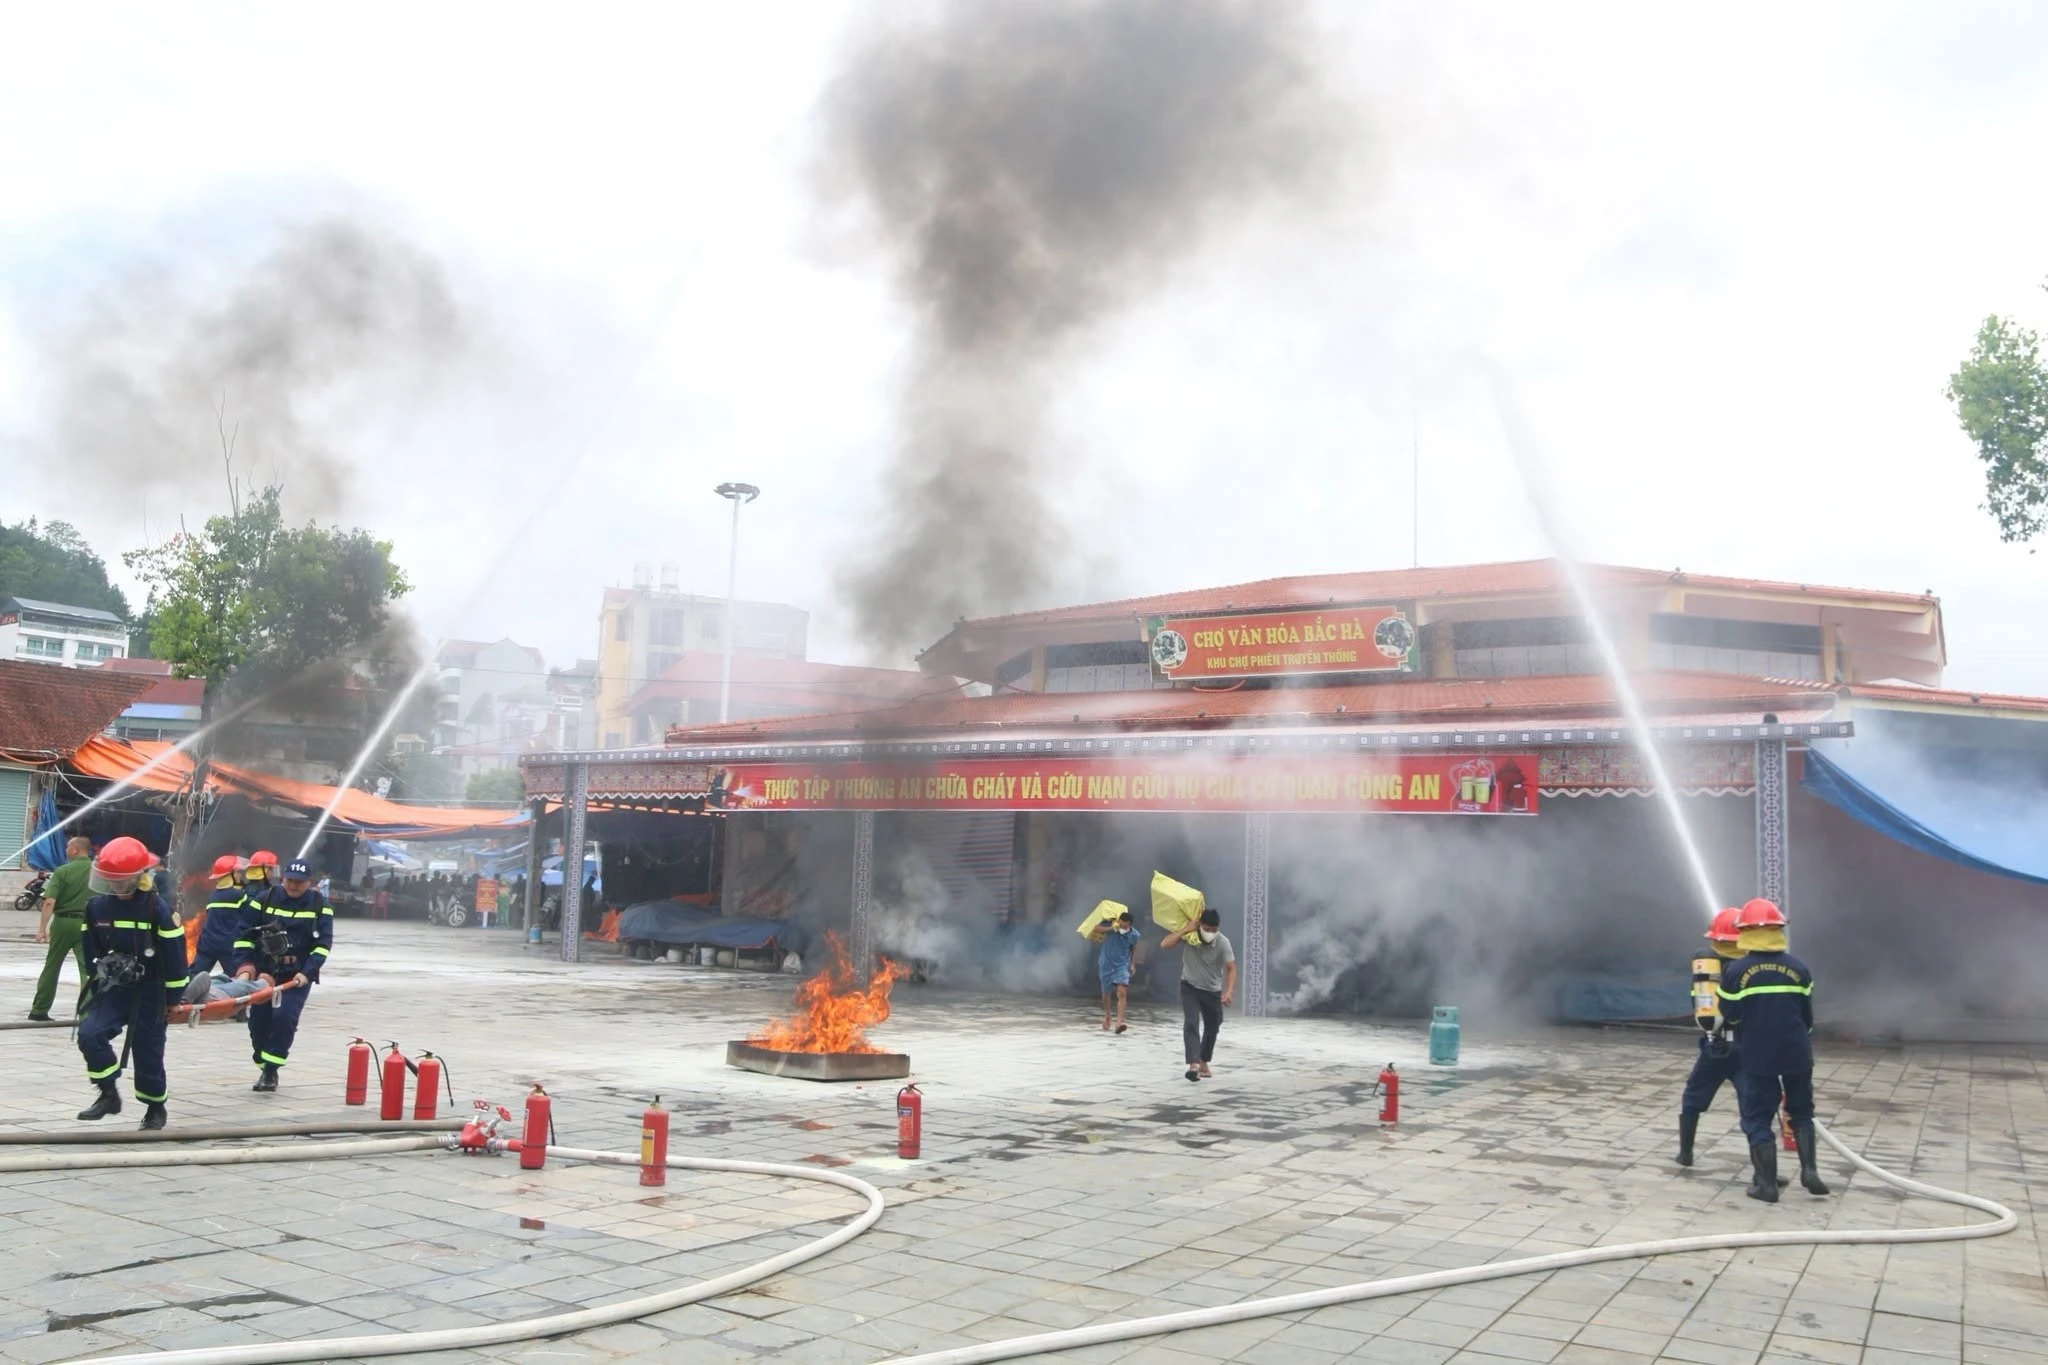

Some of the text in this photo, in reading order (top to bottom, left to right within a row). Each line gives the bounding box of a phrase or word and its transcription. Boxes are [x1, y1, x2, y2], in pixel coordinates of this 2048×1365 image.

[1193, 615, 1366, 651] CHỢ VĂN HÓA BẮC HÀ
[1207, 656, 1226, 669] KHU
[1229, 655, 1248, 671] CHỢ
[1250, 652, 1280, 667] PHIÊN
[764, 777, 799, 804] THỰC
[803, 774, 830, 804] TẬP
[834, 776, 895, 800] PHƯƠNG
[925, 772, 968, 800] CHỮA
[973, 771, 1017, 799] CHÁY
[1021, 771, 1043, 799] VÀ
[1047, 771, 1083, 799] CỨU
[1088, 775, 1126, 804] NẠN
[1344, 770, 1403, 800] CÔNG
[1408, 773, 1441, 800] AN
[291, 864, 306, 872] 114
